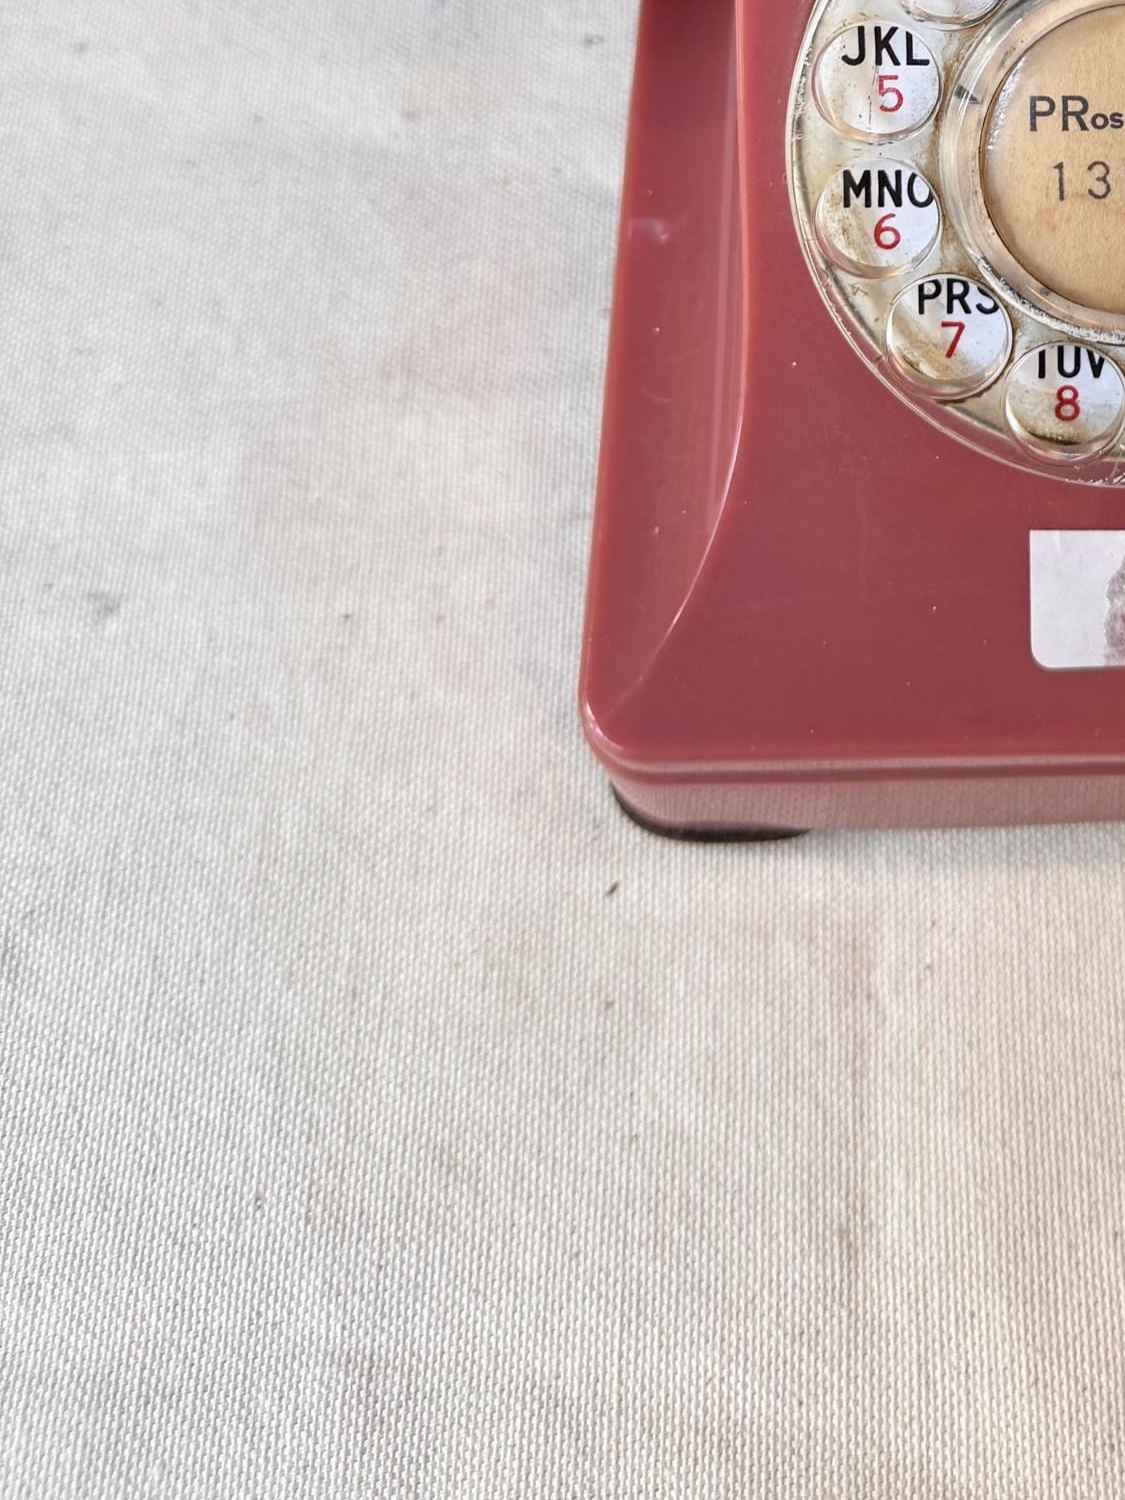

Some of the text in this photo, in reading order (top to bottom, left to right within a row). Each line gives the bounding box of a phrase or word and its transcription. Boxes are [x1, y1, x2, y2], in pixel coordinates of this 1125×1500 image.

[842, 25, 930, 66] JKL
[878, 75, 904, 113] 5
[843, 170, 934, 208] MNO
[874, 213, 901, 250] 6
[917, 279, 999, 315] PRS
[941, 321, 965, 358] 7
[1054, 385, 1081, 422] 8
